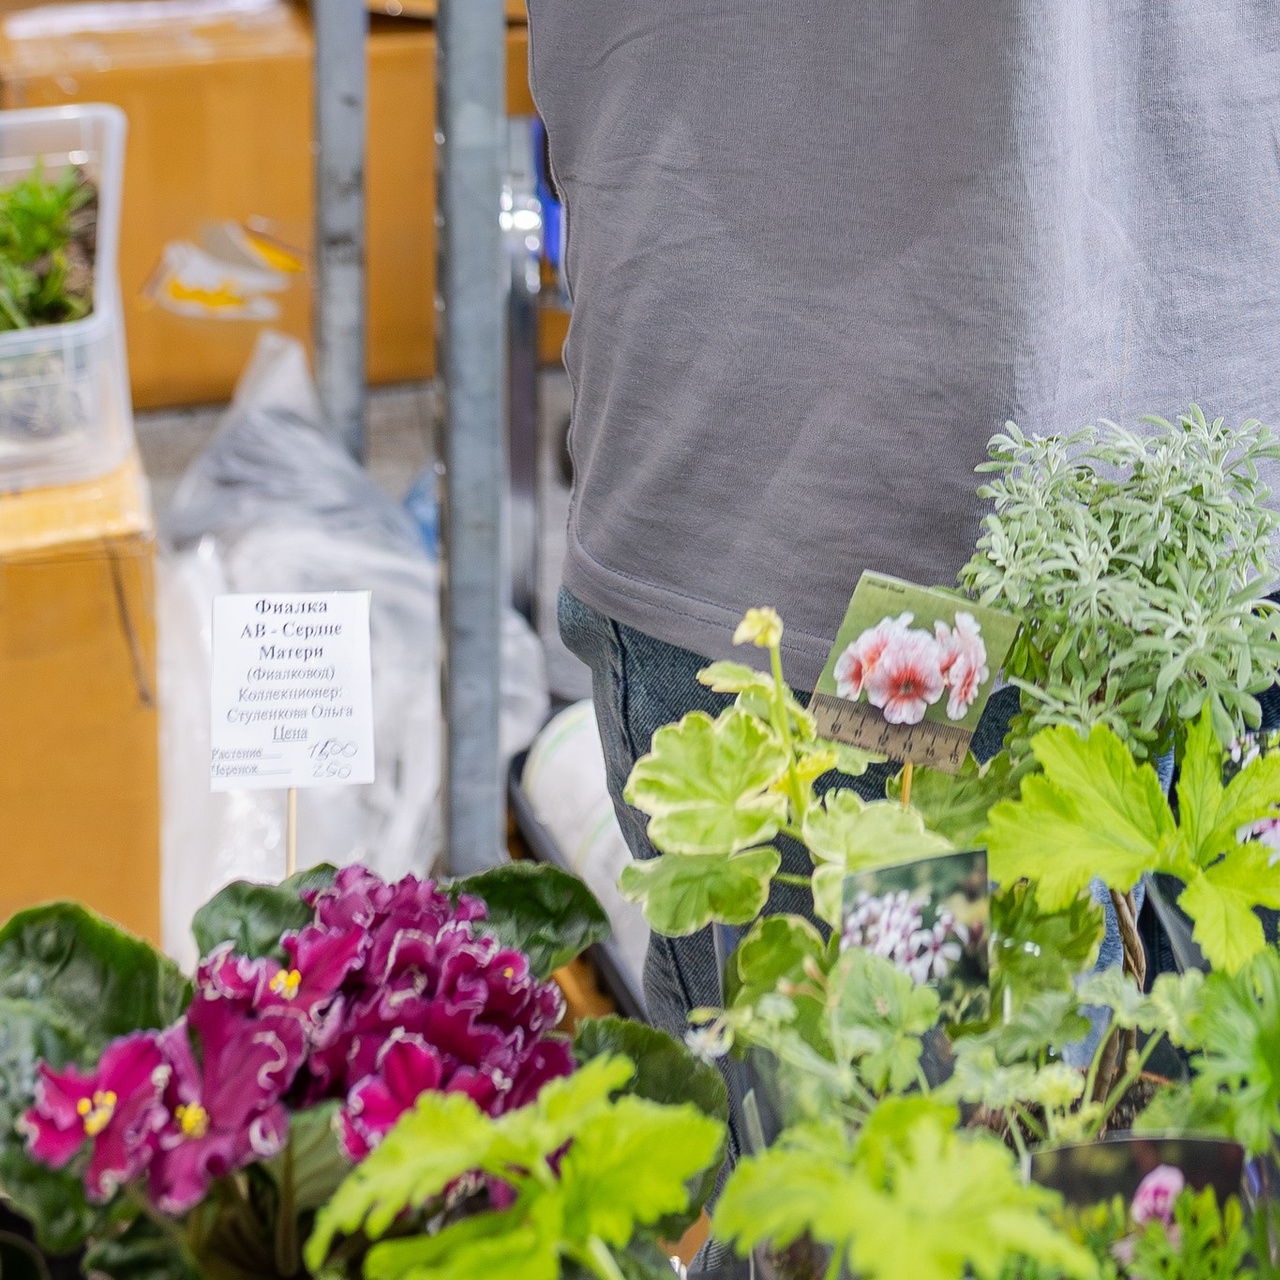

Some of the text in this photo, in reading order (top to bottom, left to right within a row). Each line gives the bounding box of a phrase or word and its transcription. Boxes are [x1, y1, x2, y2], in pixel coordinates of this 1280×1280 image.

[255, 598, 328, 615] Фиалка
[282, 621, 342, 640] Сердце
[259, 645, 323, 662] Матери
[246, 666, 336, 684] (Фиалковод)
[311, 703, 354, 719] Ольга
[272, 724, 308, 742] Цена
